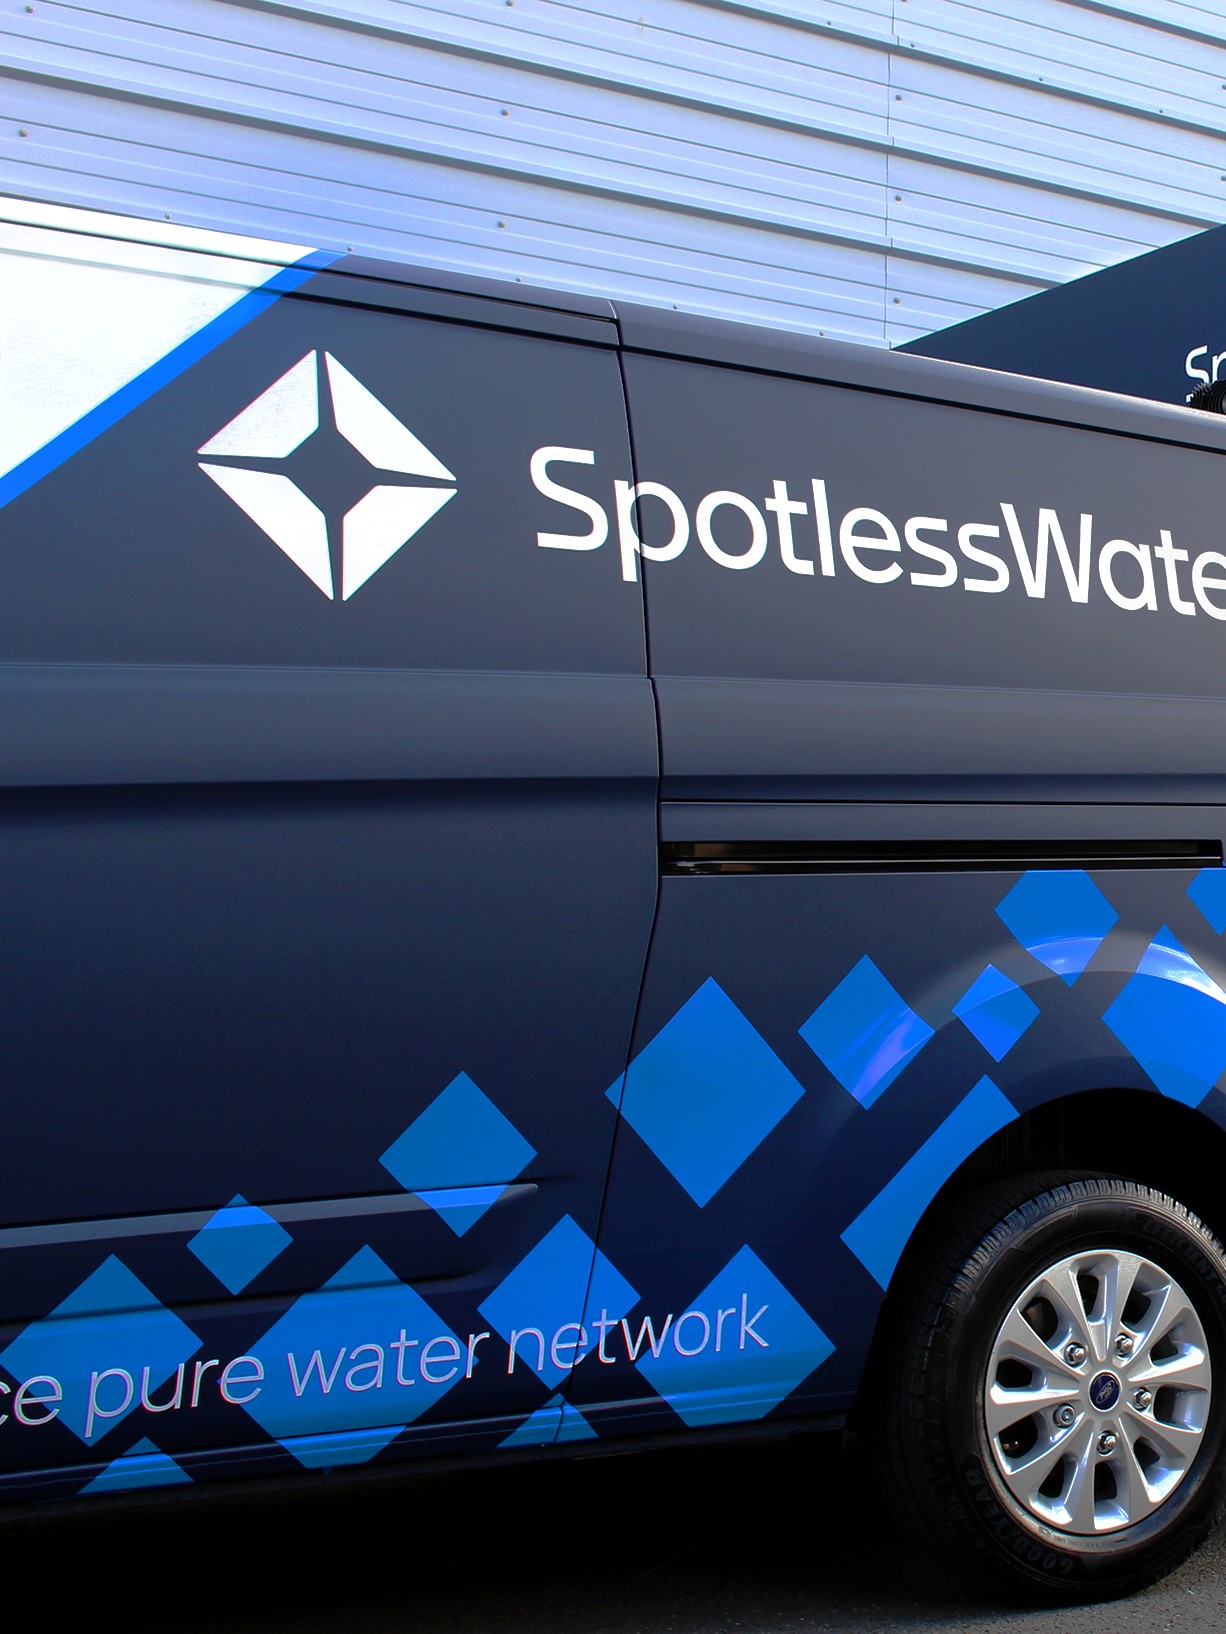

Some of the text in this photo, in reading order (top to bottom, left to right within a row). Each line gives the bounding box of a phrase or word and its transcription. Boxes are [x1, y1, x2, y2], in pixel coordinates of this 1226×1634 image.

[85, 1354, 265, 1438] pure
[287, 1327, 490, 1396] water
[507, 1293, 770, 1374] network
[963, 1465, 1075, 1575] GOODYEAR
